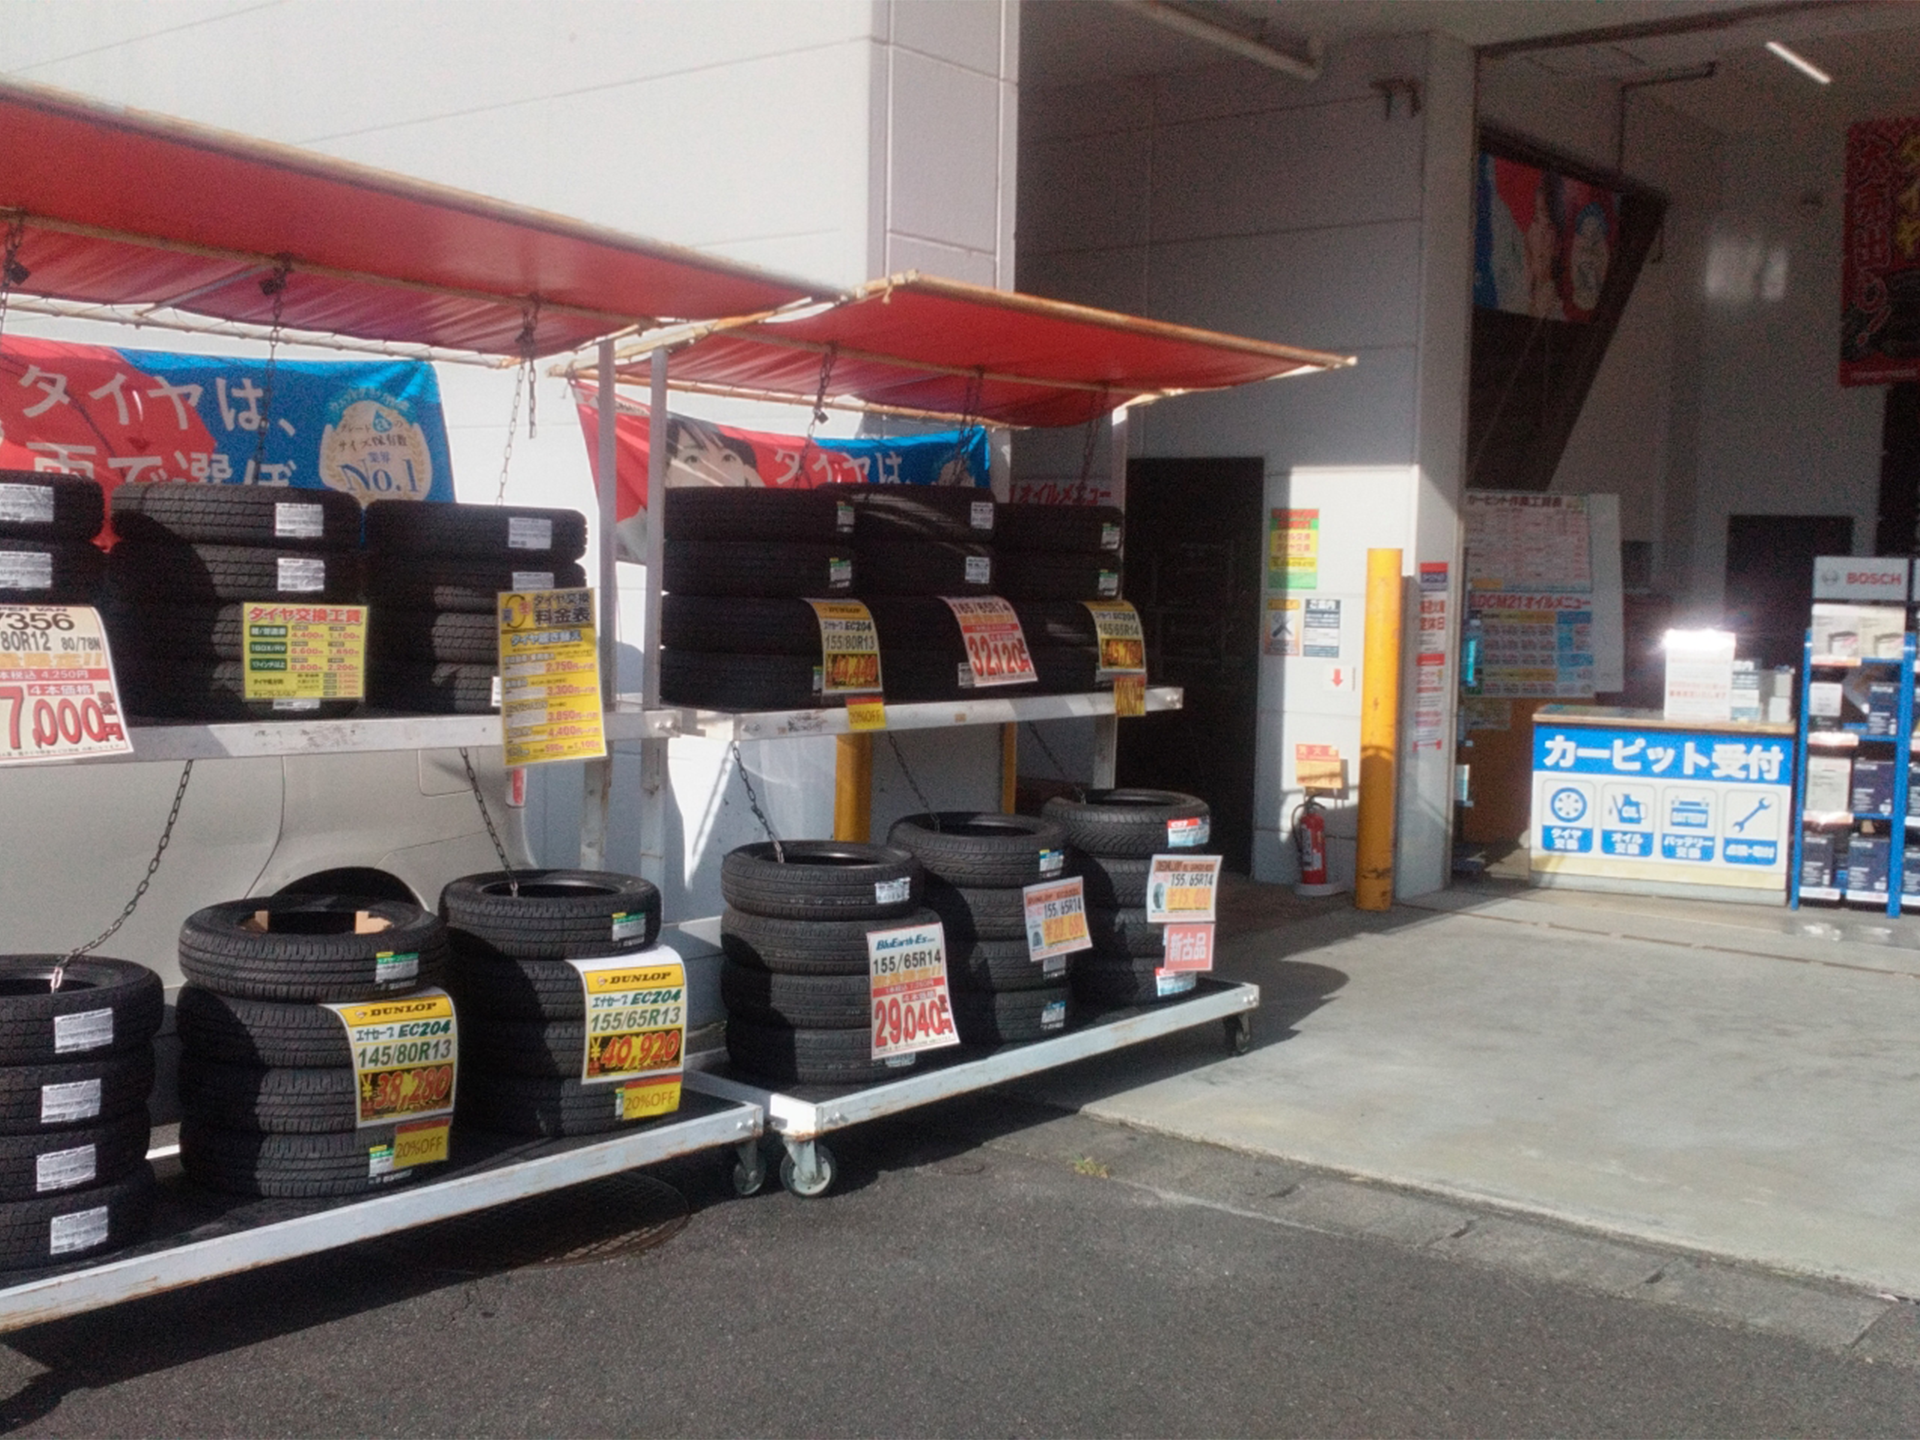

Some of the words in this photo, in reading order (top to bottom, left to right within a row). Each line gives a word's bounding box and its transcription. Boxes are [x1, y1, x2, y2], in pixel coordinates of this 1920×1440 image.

[19, 365, 296, 437] タイヤは、
[339, 457, 419, 493] No.1
[774, 447, 914, 486] タイヤは
[1846, 572, 1902, 585] BOSCH
[535, 607, 590, 626] 料金表
[0, 631, 52, 651] 80R12
[1543, 735, 1784, 780] カーピット受付
[1551, 828, 1582, 839] タイヤ
[1612, 833, 1643, 844] オイル
[1664, 836, 1714, 850] バッテリー
[1170, 933, 1206, 961] 新古品
[873, 949, 942, 975] 155/65R14
[610, 972, 672, 985] DUNLOP
[630, 988, 683, 1006] EC204
[370, 1002, 437, 1017] DUNLOP
[591, 1006, 681, 1033] 155/65R13
[399, 1020, 452, 1039] EC204
[358, 1039, 452, 1068] 145/80R13
[625, 1091, 676, 1111] 20%OFF
[396, 1136, 443, 1159] 20%OFF
